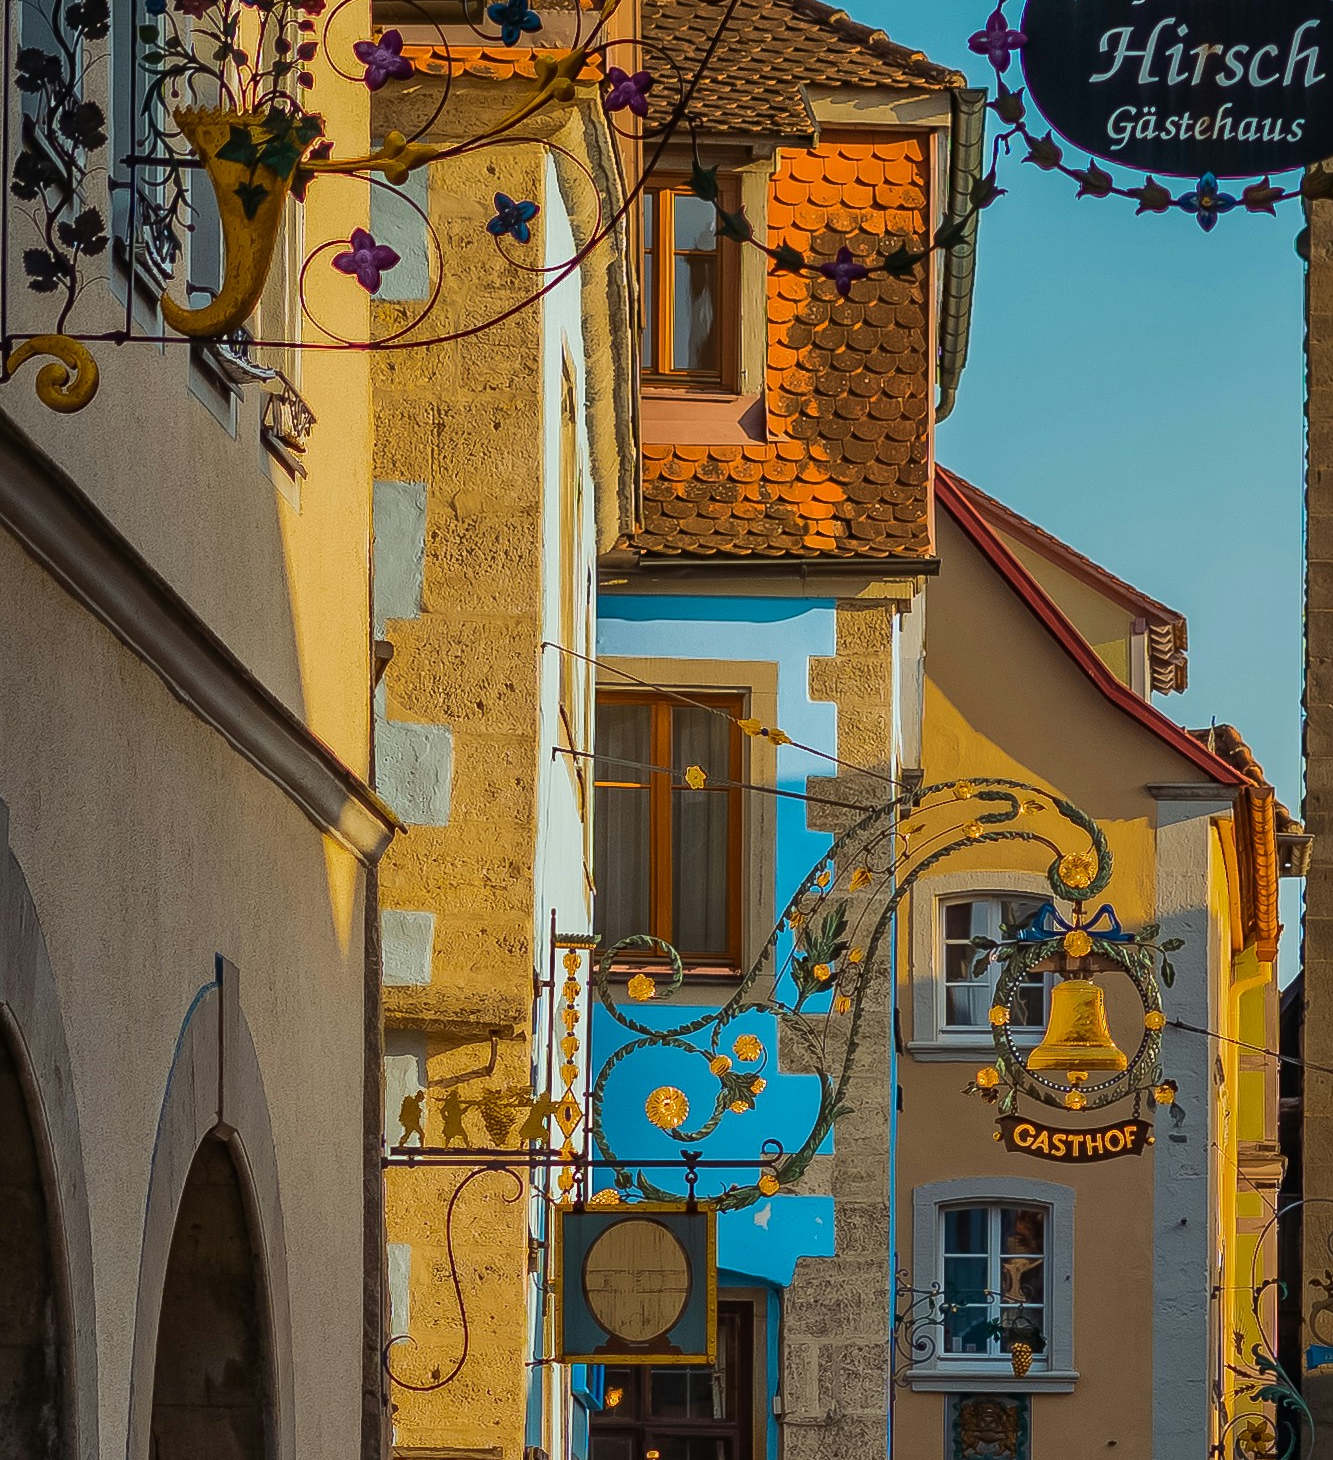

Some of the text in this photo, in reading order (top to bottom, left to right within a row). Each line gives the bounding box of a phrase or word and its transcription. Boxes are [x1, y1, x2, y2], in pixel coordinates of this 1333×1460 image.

[1088, 16, 1326, 88] Hirsch
[1106, 102, 1306, 151] Gästehaus
[1013, 1123, 1138, 1157] GASTHOF
